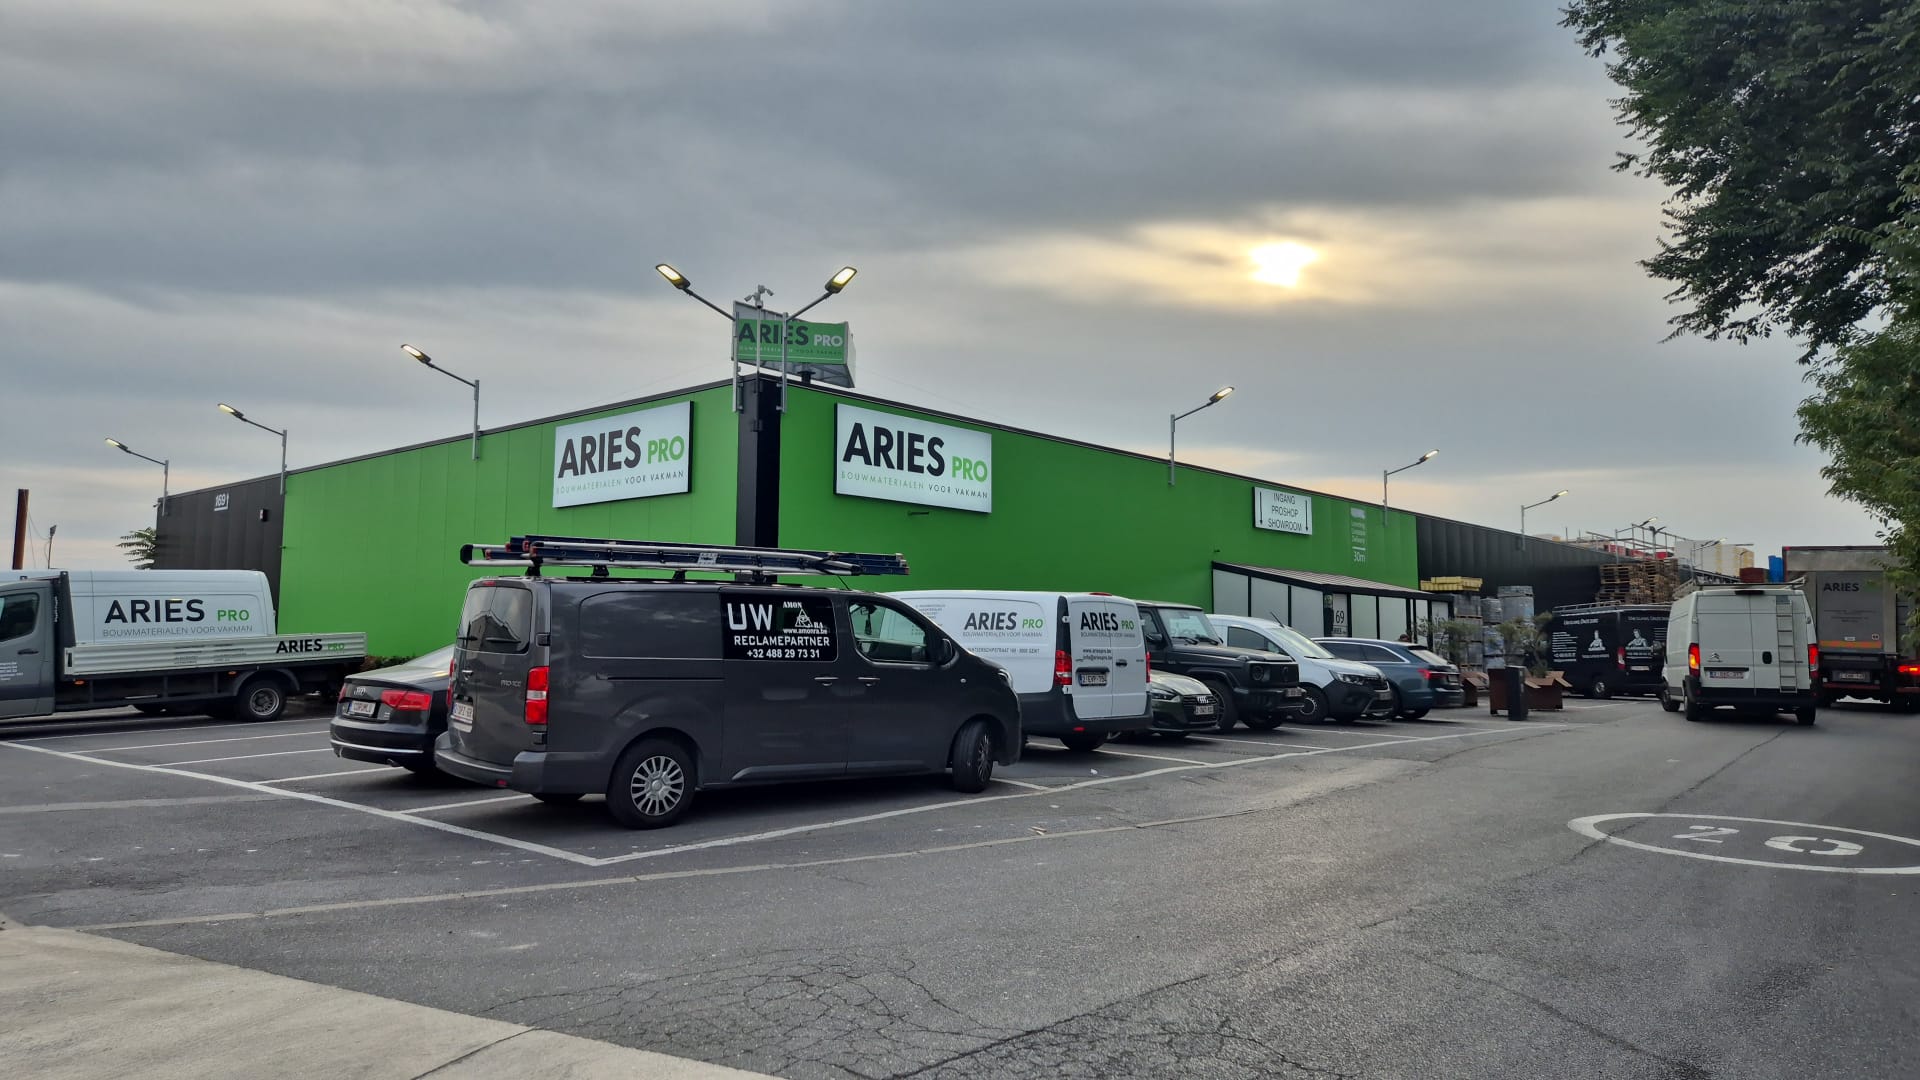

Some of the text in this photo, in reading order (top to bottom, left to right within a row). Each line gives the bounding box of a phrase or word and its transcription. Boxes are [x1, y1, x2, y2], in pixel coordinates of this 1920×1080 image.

[738, 323, 843, 347] ARIES PRO
[558, 426, 685, 478] ARIES PRO
[842, 422, 988, 483] ARIES PRO
[555, 470, 684, 495] BOUWMATERIALEN VOOR VAKMAN
[841, 471, 988, 499] BOUWMATERIALEN VOOR VAKMAN
[1273, 492, 1296, 505] INGANG
[1271, 505, 1299, 518] PROSHOP
[1268, 518, 1303, 532] SHOWROOM
[1823, 582, 1860, 592] ARIES
[104, 599, 250, 624] ARIES PRO
[782, 601, 803, 609] AMON
[727, 603, 773, 631] UW
[964, 612, 1044, 631] ARIES PRO
[1080, 611, 1135, 631] ARIES PRO
[103, 625, 253, 637] BOUWMATERIALEN VOOR VAKMAN
[276, 638, 345, 654] ARIES PRO
[734, 635, 830, 647] RECLAMEPARTNER
[747, 648, 820, 658] +32 488 29 73 31
[1673, 825, 1864, 856] 20
